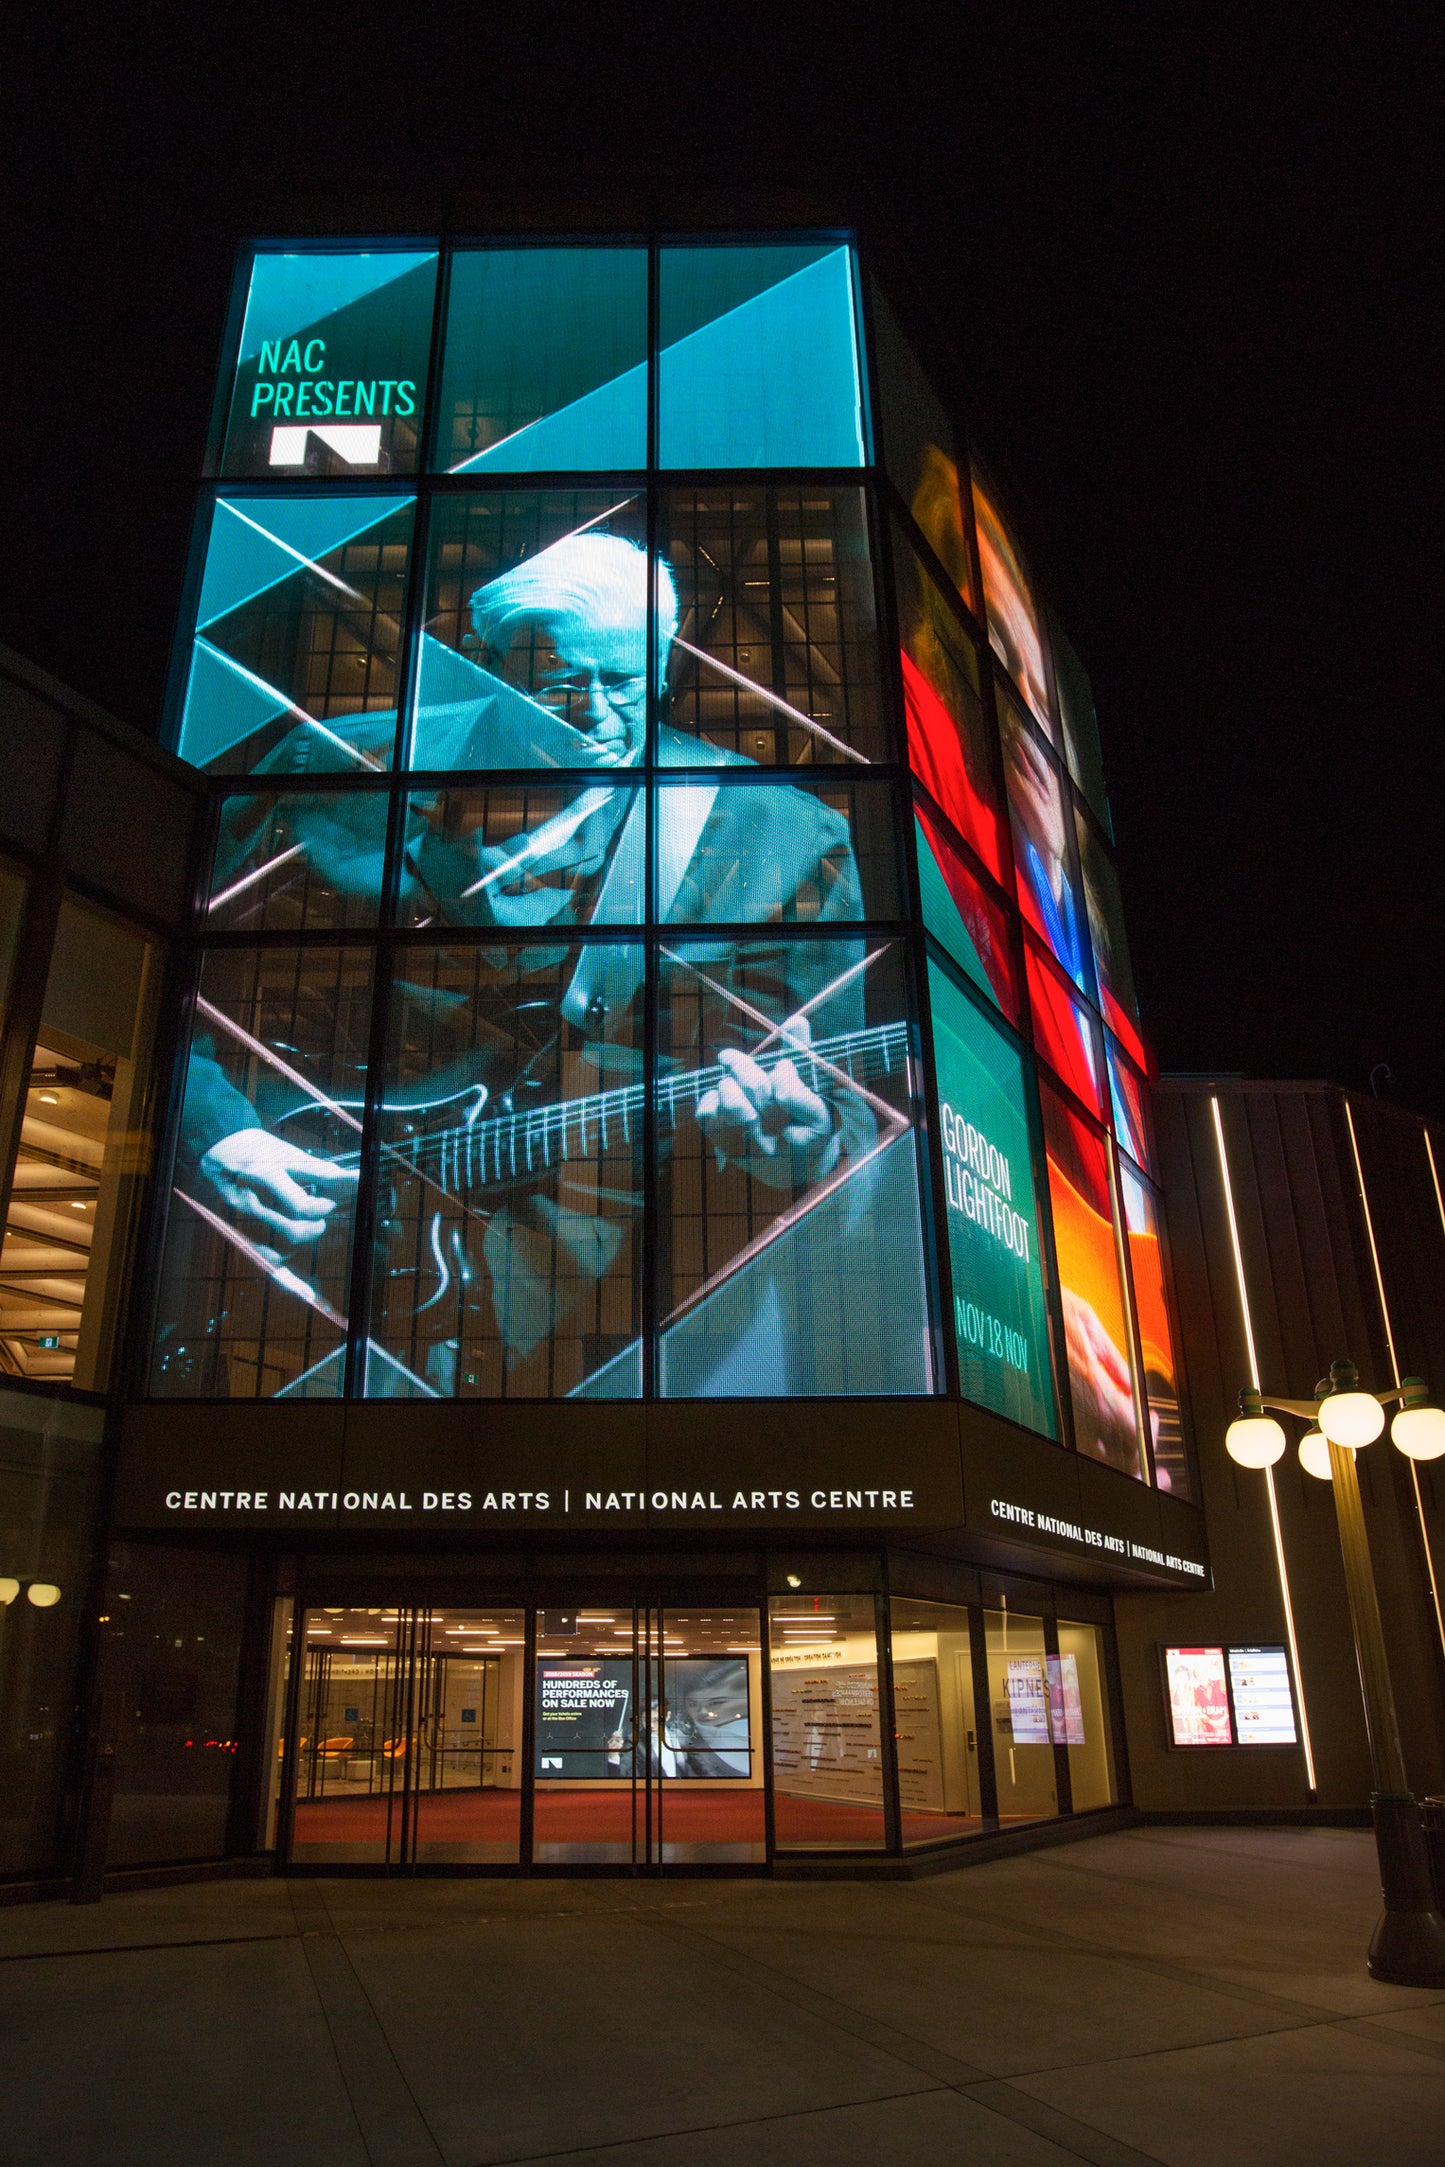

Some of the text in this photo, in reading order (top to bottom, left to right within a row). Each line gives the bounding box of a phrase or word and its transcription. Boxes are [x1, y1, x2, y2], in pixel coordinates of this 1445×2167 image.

[259, 339, 326, 373] NAC
[250, 380, 416, 417] PRESENTS
[942, 1103, 1012, 1201] GORDON
[945, 1155, 1030, 1263] LIGHTFOOT
[956, 1295, 1028, 1374] NOV 18 NOV
[165, 1490, 915, 1510] CENTRE NATIONAL DES ARTS NATIONAL ARTS CENTRE
[990, 1499, 1206, 1578] CENTRE NATIONAL DES ARTS NATIONAL ARTS CENTRE
[542, 1680, 618, 1689] HUNDREDS OF
[542, 1689, 629, 1699] PERFORMANCES
[1002, 1678, 1050, 1698] KIPNES
[542, 1699, 616, 1708] ON SALE NOW
